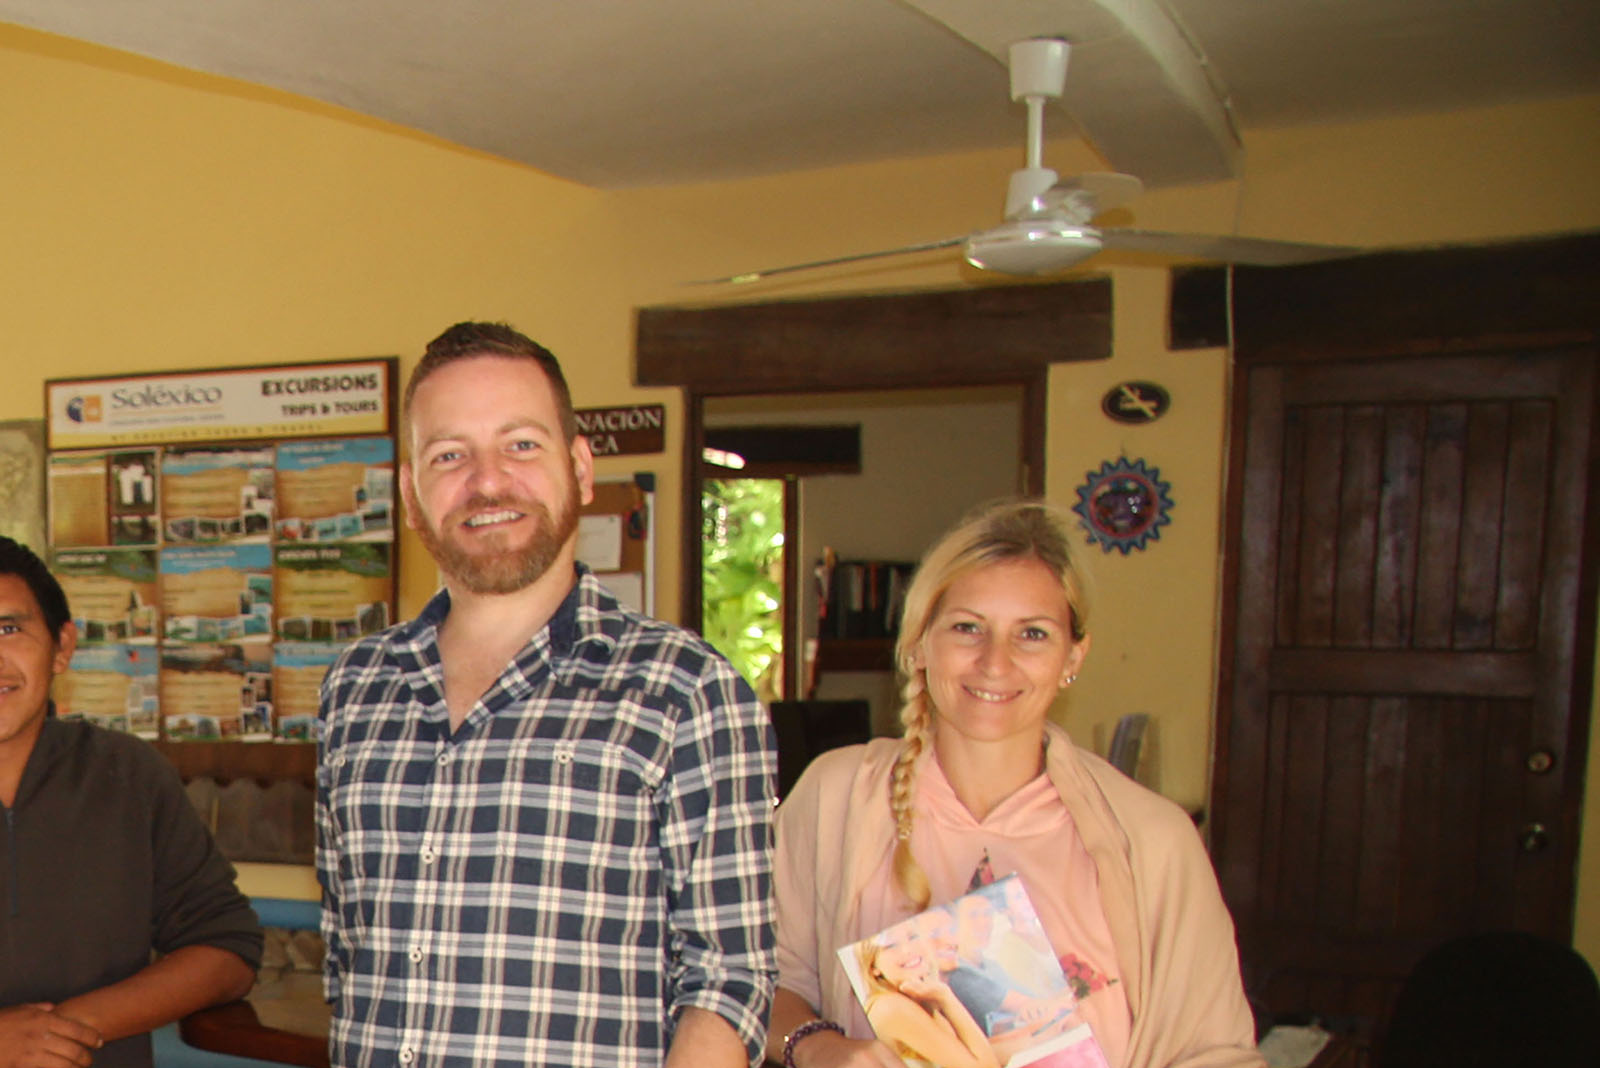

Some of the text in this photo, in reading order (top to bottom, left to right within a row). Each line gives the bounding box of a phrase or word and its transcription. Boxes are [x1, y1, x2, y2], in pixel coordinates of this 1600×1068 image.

[261, 373, 379, 396] EXCURSIONS
[281, 399, 378, 416] TRIPS & TOURS
[575, 406, 662, 432] NACIÓN
[590, 434, 619, 457] CA
